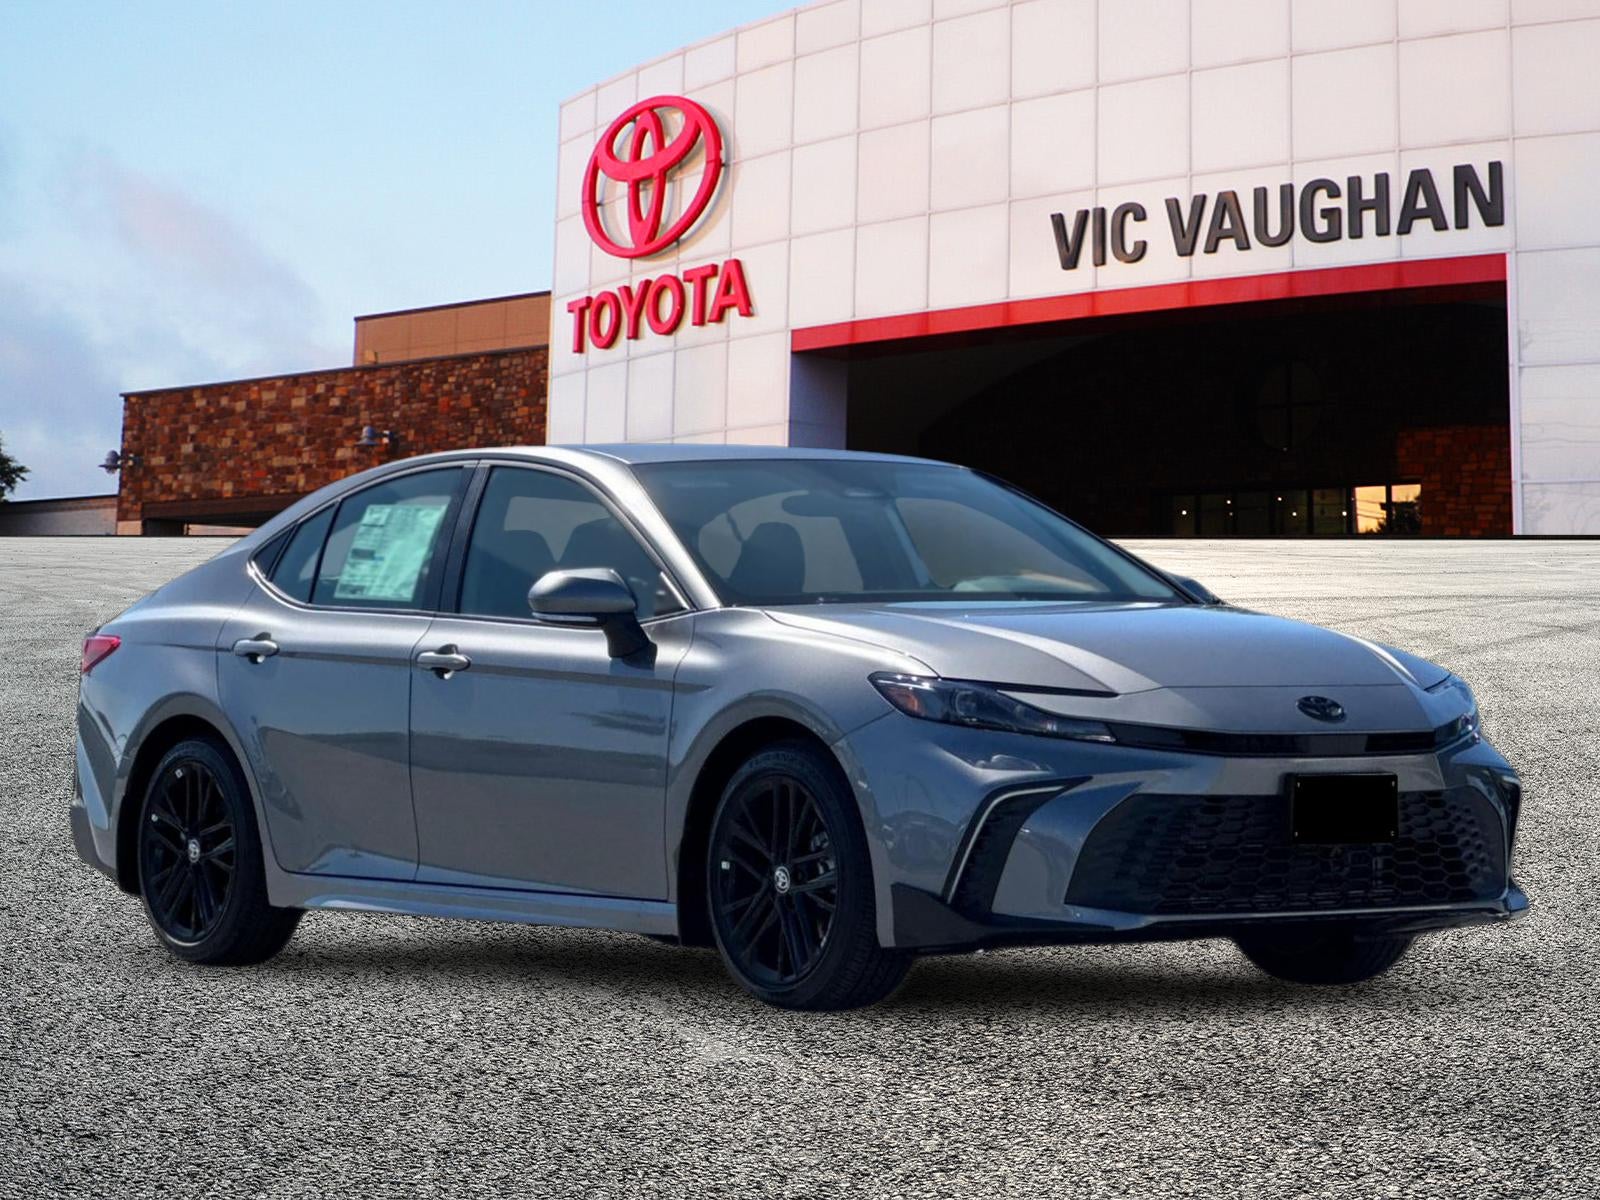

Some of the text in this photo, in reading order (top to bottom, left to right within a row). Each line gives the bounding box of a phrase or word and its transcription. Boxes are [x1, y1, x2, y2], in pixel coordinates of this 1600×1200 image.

[1050, 160, 1505, 271] VIC VAUGHAN
[567, 259, 754, 353] TOYOTA
